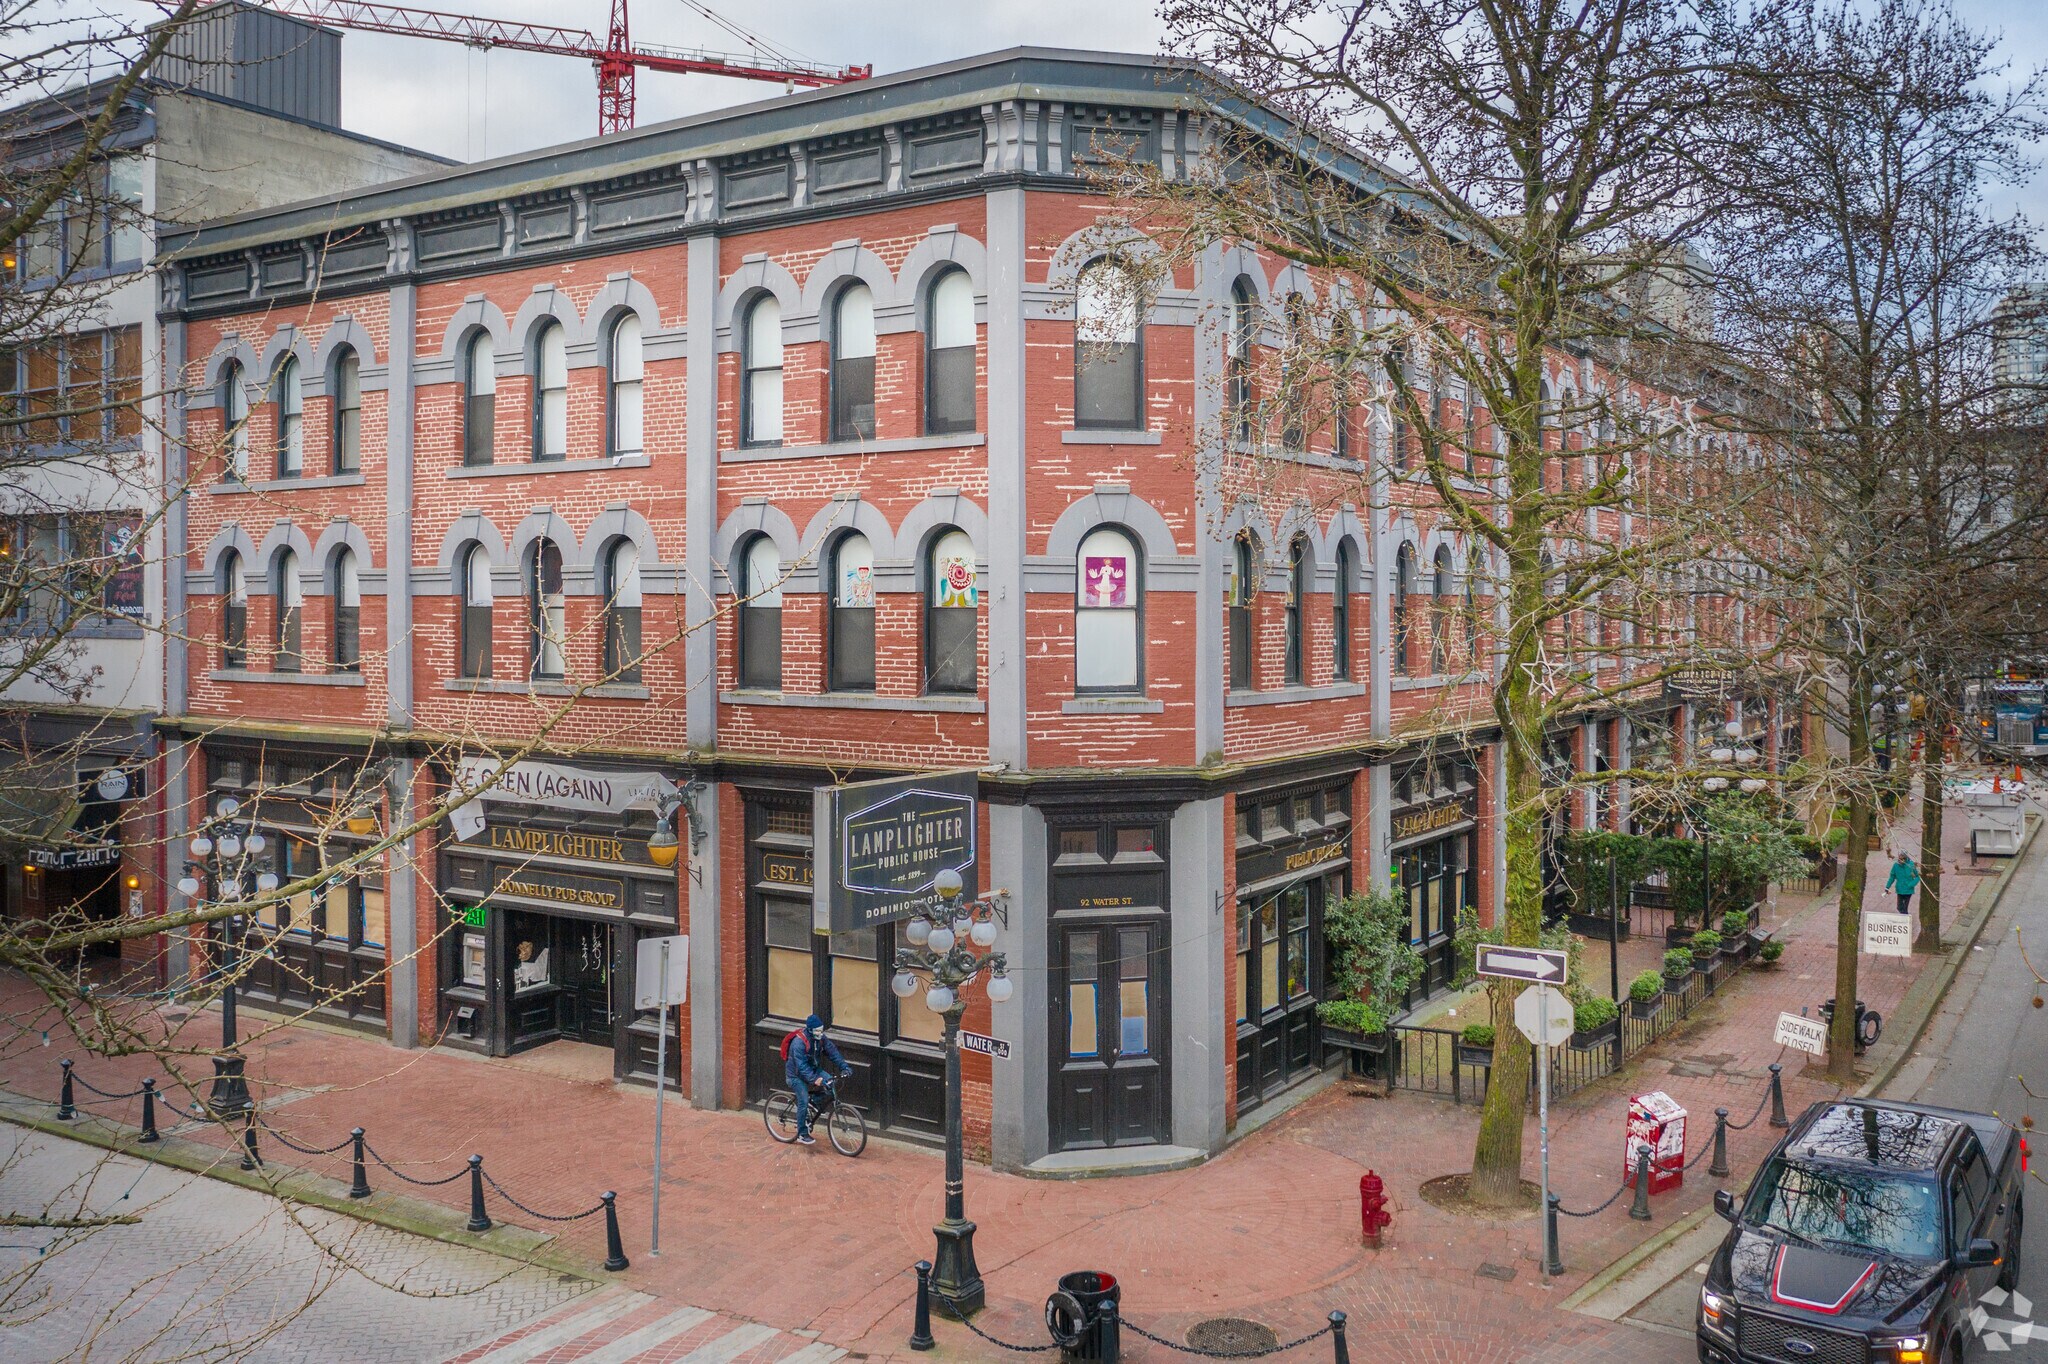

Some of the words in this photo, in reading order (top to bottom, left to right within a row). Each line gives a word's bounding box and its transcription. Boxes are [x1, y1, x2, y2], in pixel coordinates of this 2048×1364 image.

[101, 780, 126, 788] RAIN
[481, 768, 531, 794] OEN
[536, 769, 612, 807] (AGAIN)
[902, 811, 916, 823] THE
[491, 827, 625, 861] LAMPLIGHTER
[851, 816, 963, 858] LAMPLIGHTER
[878, 853, 909, 870] PUBLIC
[912, 847, 939, 862] HOUSE
[770, 864, 799, 881] EST.
[908, 870, 921, 880] 1899
[500, 880, 556, 898] DONNELLY
[556, 886, 577, 901] PUB
[579, 889, 616, 906] GROUP
[1080, 898, 1090, 907] 92
[1092, 897, 1120, 906] WATER
[1121, 897, 1134, 905] ST.
[866, 898, 919, 919] DOMINIO
[1867, 923, 1909, 935] BUSINESS
[1876, 935, 1899, 945] OPEN
[1779, 1020, 1822, 1042] SIDEWALK
[966, 1034, 993, 1052] WATER
